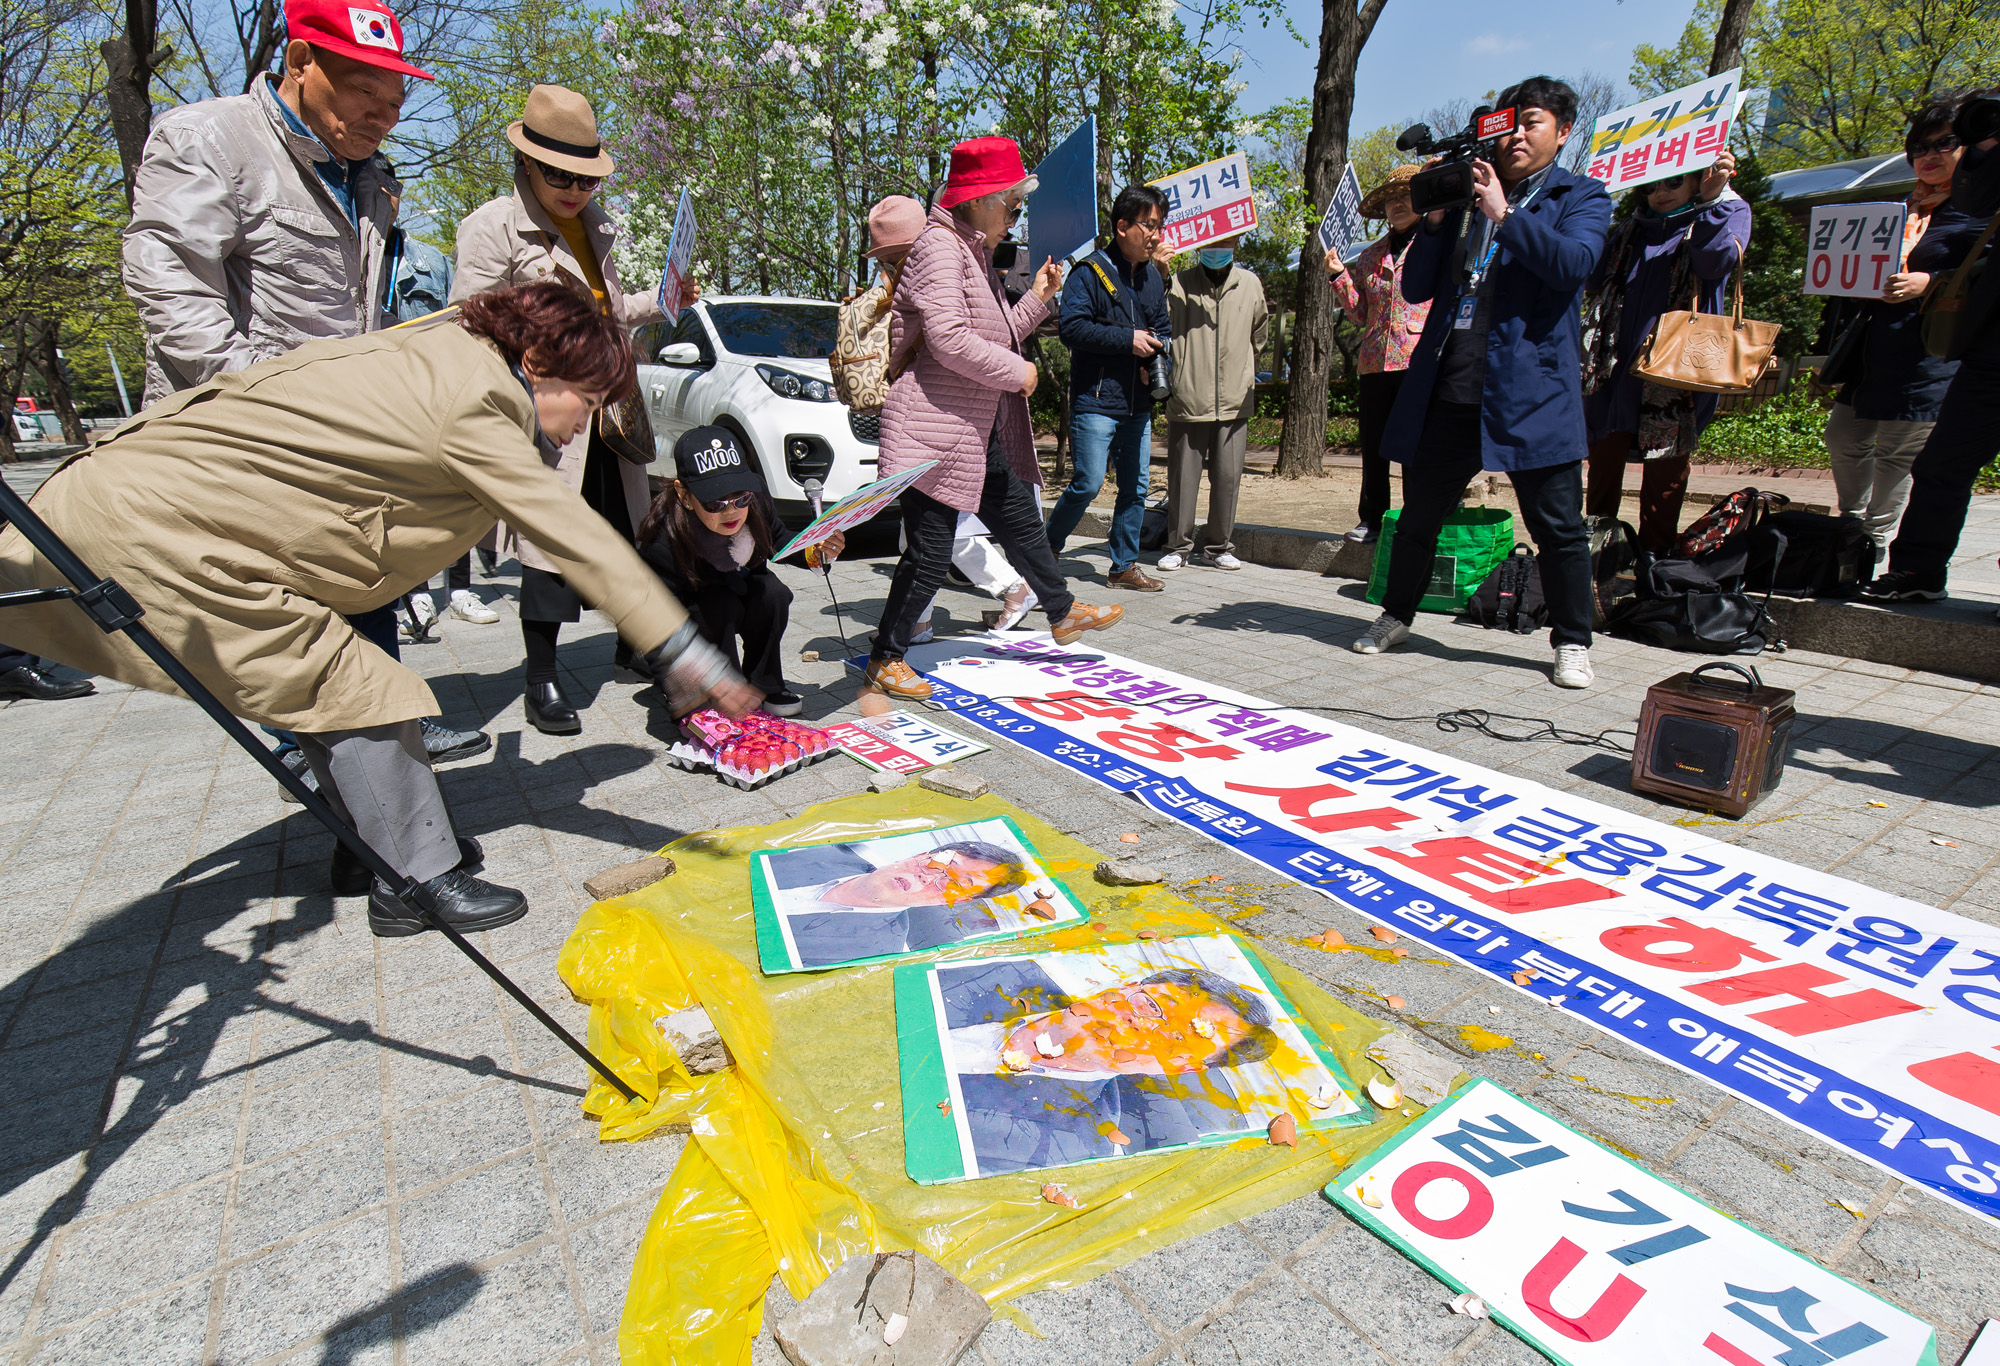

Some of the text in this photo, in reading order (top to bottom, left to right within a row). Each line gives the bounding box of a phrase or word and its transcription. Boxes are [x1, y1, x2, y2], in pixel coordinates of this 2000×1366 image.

[1484, 112, 1508, 126] MBC
[1484, 121, 1508, 134] NEWS
[1163, 202, 1253, 248] 사퇴가 답!
[828, 727, 890, 755] 사퇴가
[983, 640, 1220, 716] 문재인정권의
[1207, 707, 1333, 752] 적폐
[1316, 749, 1519, 822] 김기식
[1013, 690, 1246, 762] 당장
[1053, 741, 1111, 768] 장소:
[1287, 850, 1395, 902] 단체:
[1391, 1161, 1767, 1366] OU
